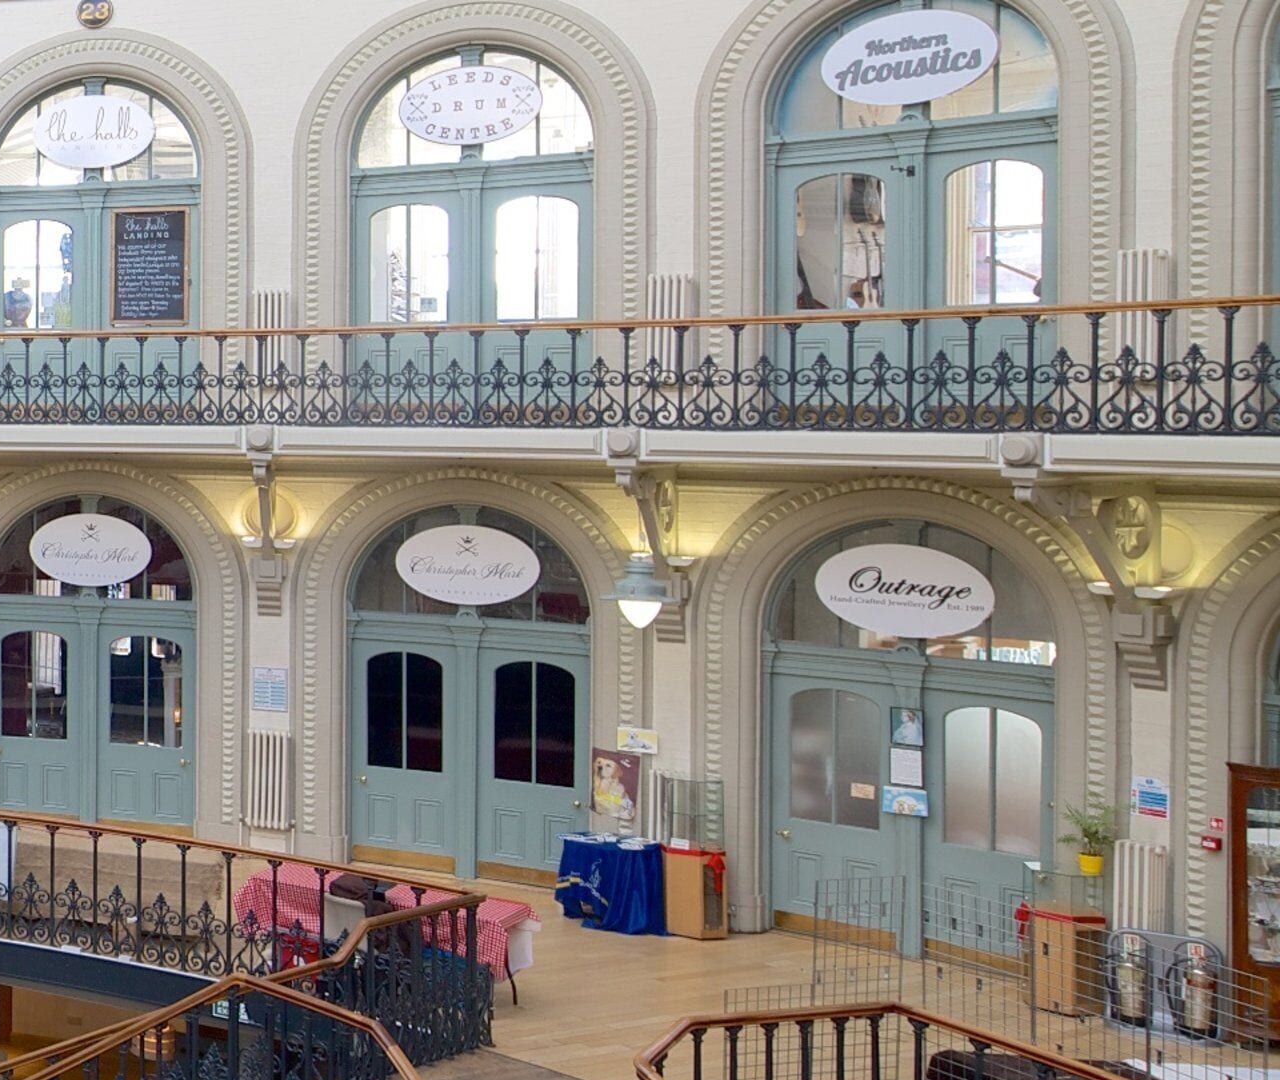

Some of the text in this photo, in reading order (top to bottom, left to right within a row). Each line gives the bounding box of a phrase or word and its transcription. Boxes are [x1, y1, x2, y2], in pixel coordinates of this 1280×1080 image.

[80, 2, 109, 19] 23
[865, 33, 949, 57] Northern
[835, 48, 983, 91] Acoustics
[429, 72, 512, 91] LEEDS
[432, 98, 507, 113] DRUM
[44, 106, 138, 142] the halls
[424, 118, 514, 139] CENTRE
[123, 232, 170, 240] LANDING
[40, 542, 99, 565] Christopher
[409, 555, 527, 581] Christopher Mark
[848, 566, 972, 610] Outrage
[830, 594, 887, 606] Hand-Crafted
[887, 599, 928, 610] Jewellery
[947, 603, 963, 611] Est.
